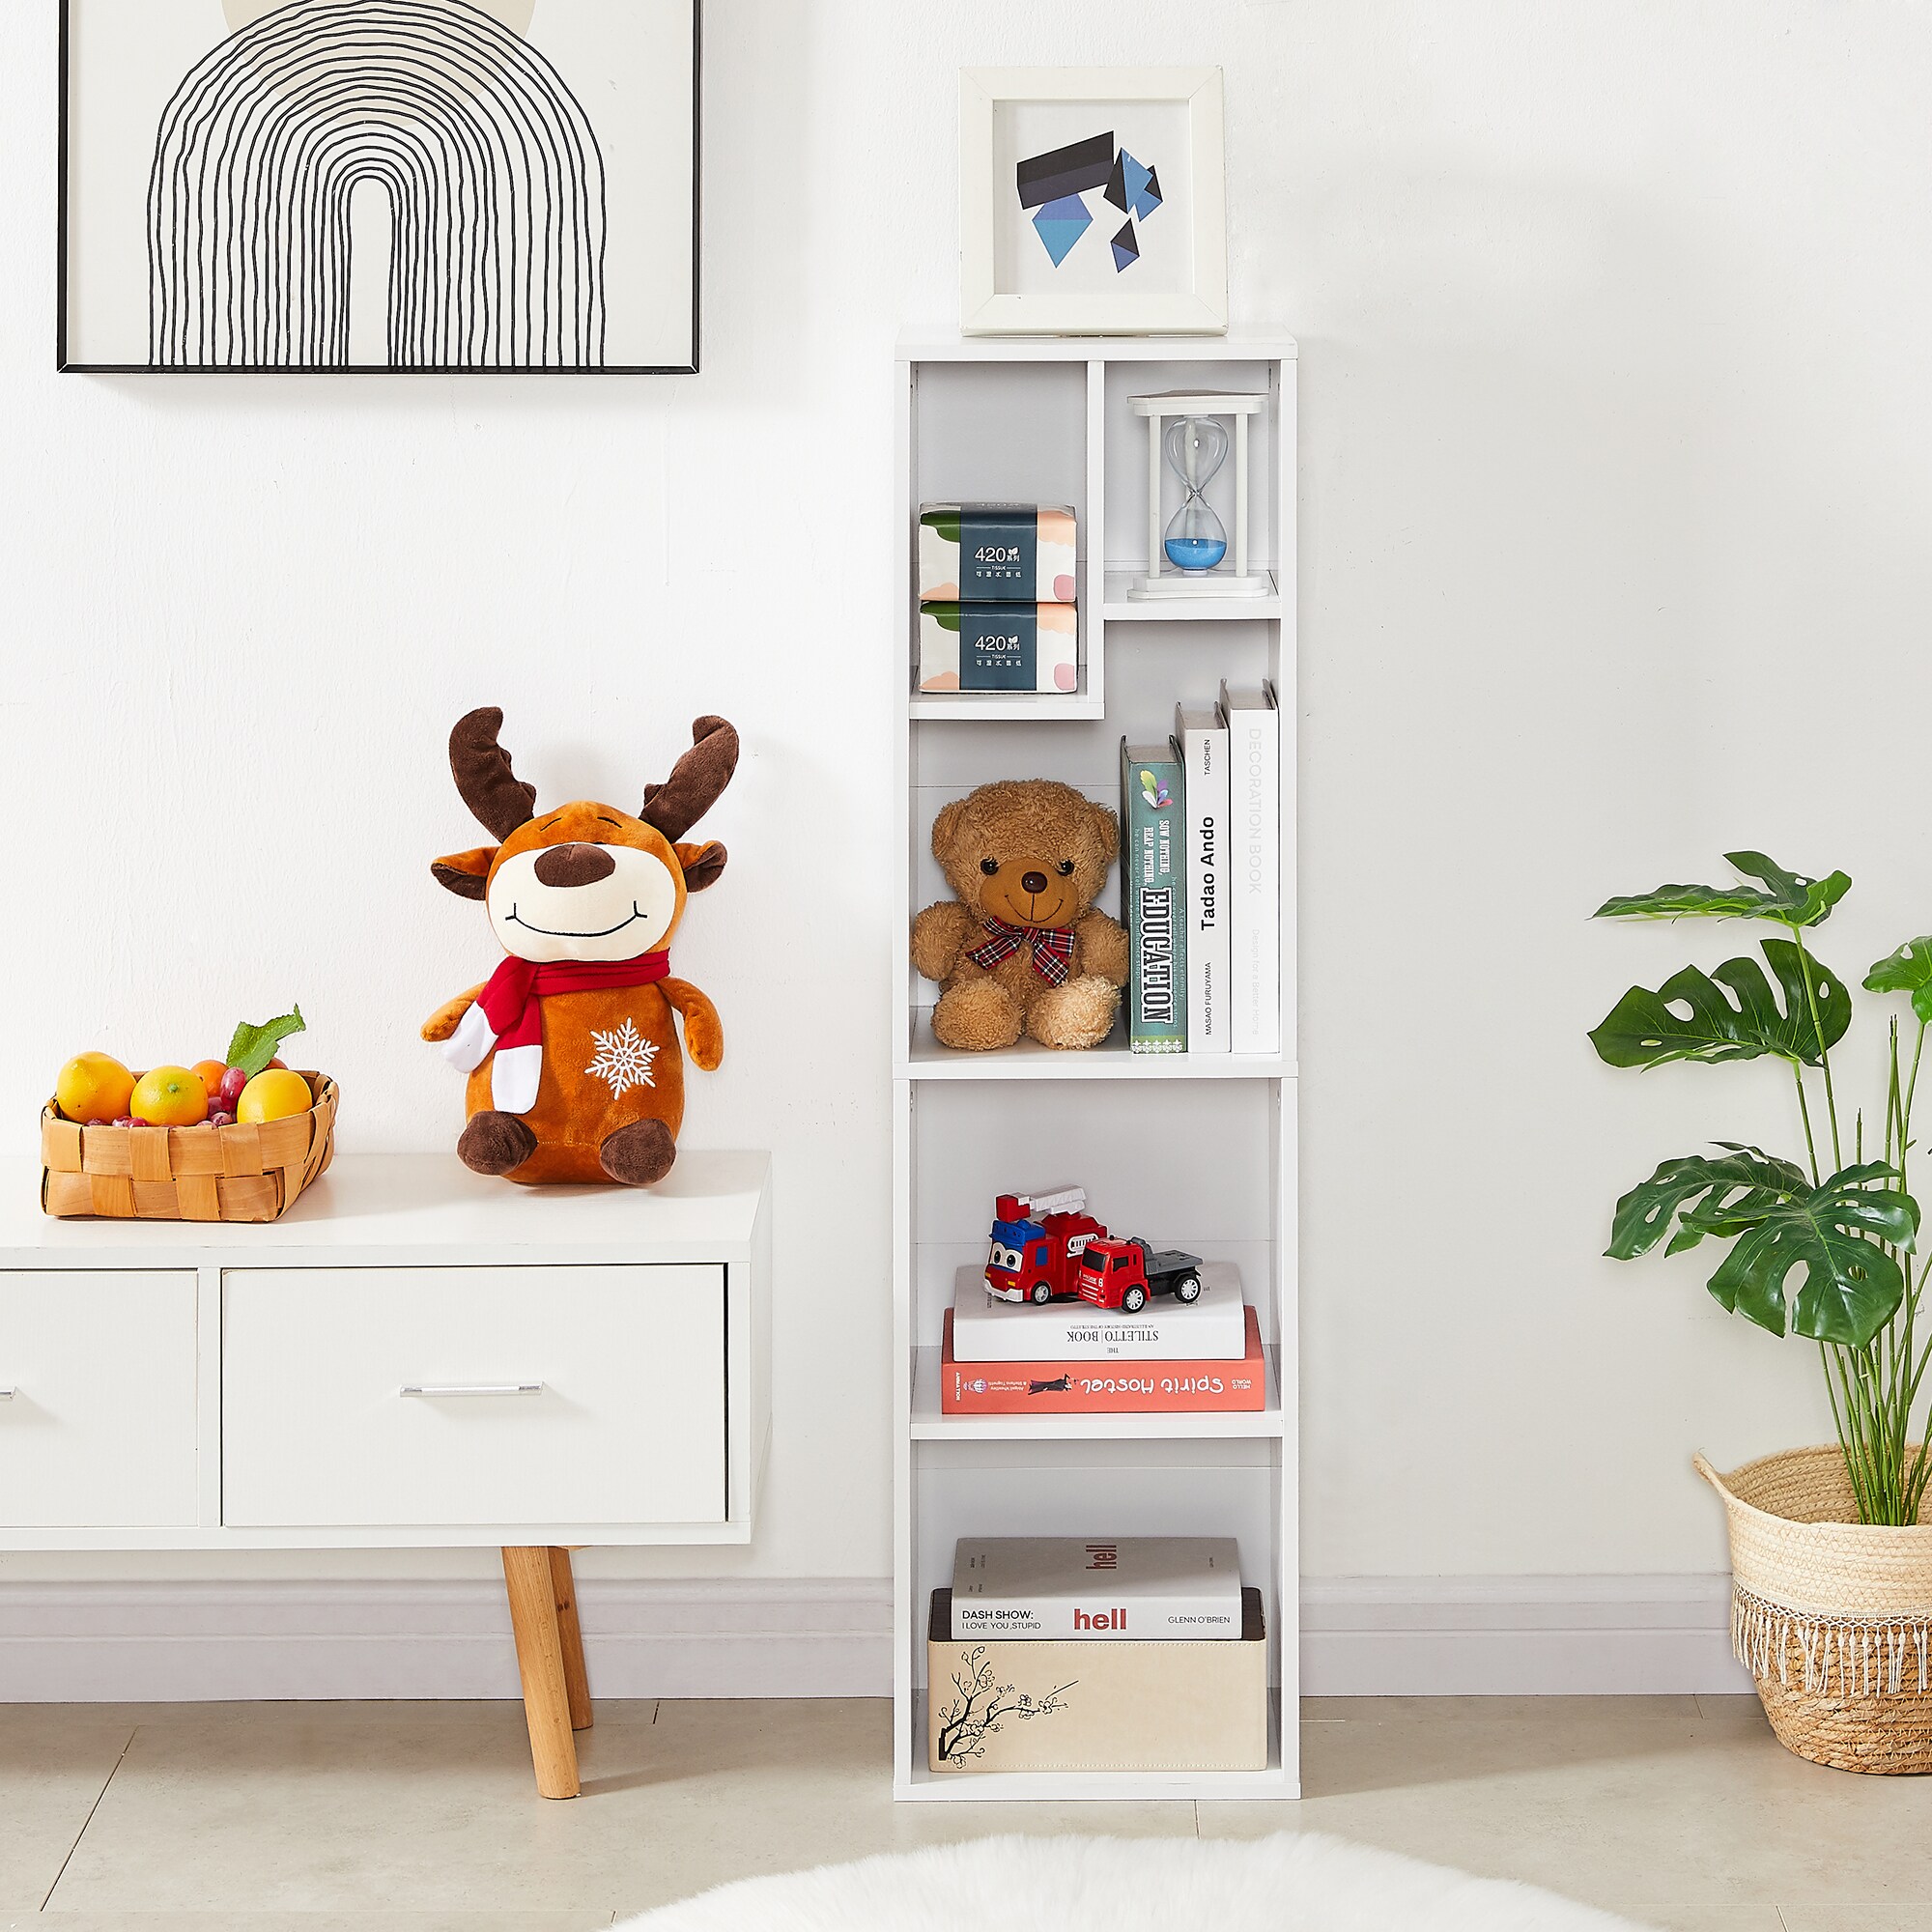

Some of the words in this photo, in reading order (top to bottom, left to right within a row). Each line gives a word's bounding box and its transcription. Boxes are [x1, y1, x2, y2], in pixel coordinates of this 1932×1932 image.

[975, 547, 1007, 562] 420
[975, 636, 1007, 651] 420
[1249, 728, 1262, 839] DECORATION
[1144, 827, 1154, 847] REAP
[1159, 819, 1170, 838] SOW
[1200, 816, 1214, 867] Ando
[1249, 844, 1262, 895] BOOK
[1201, 873, 1215, 931] Tadao
[1140, 887, 1174, 1024] EDUCATION
[1066, 1330, 1098, 1342] BOOK
[1104, 1330, 1159, 1342] STILETTO
[1080, 1378, 1154, 1394] Hostel
[1160, 1376, 1224, 1394] Spirit
[1086, 1545, 1117, 1570] hell
[962, 1610, 993, 1619] DASH
[995, 1610, 1034, 1619] SHOW:
[1073, 1608, 1127, 1630] hell
[1167, 1615, 1197, 1624] GLENN
[1197, 1615, 1231, 1624] O'BRIEN
